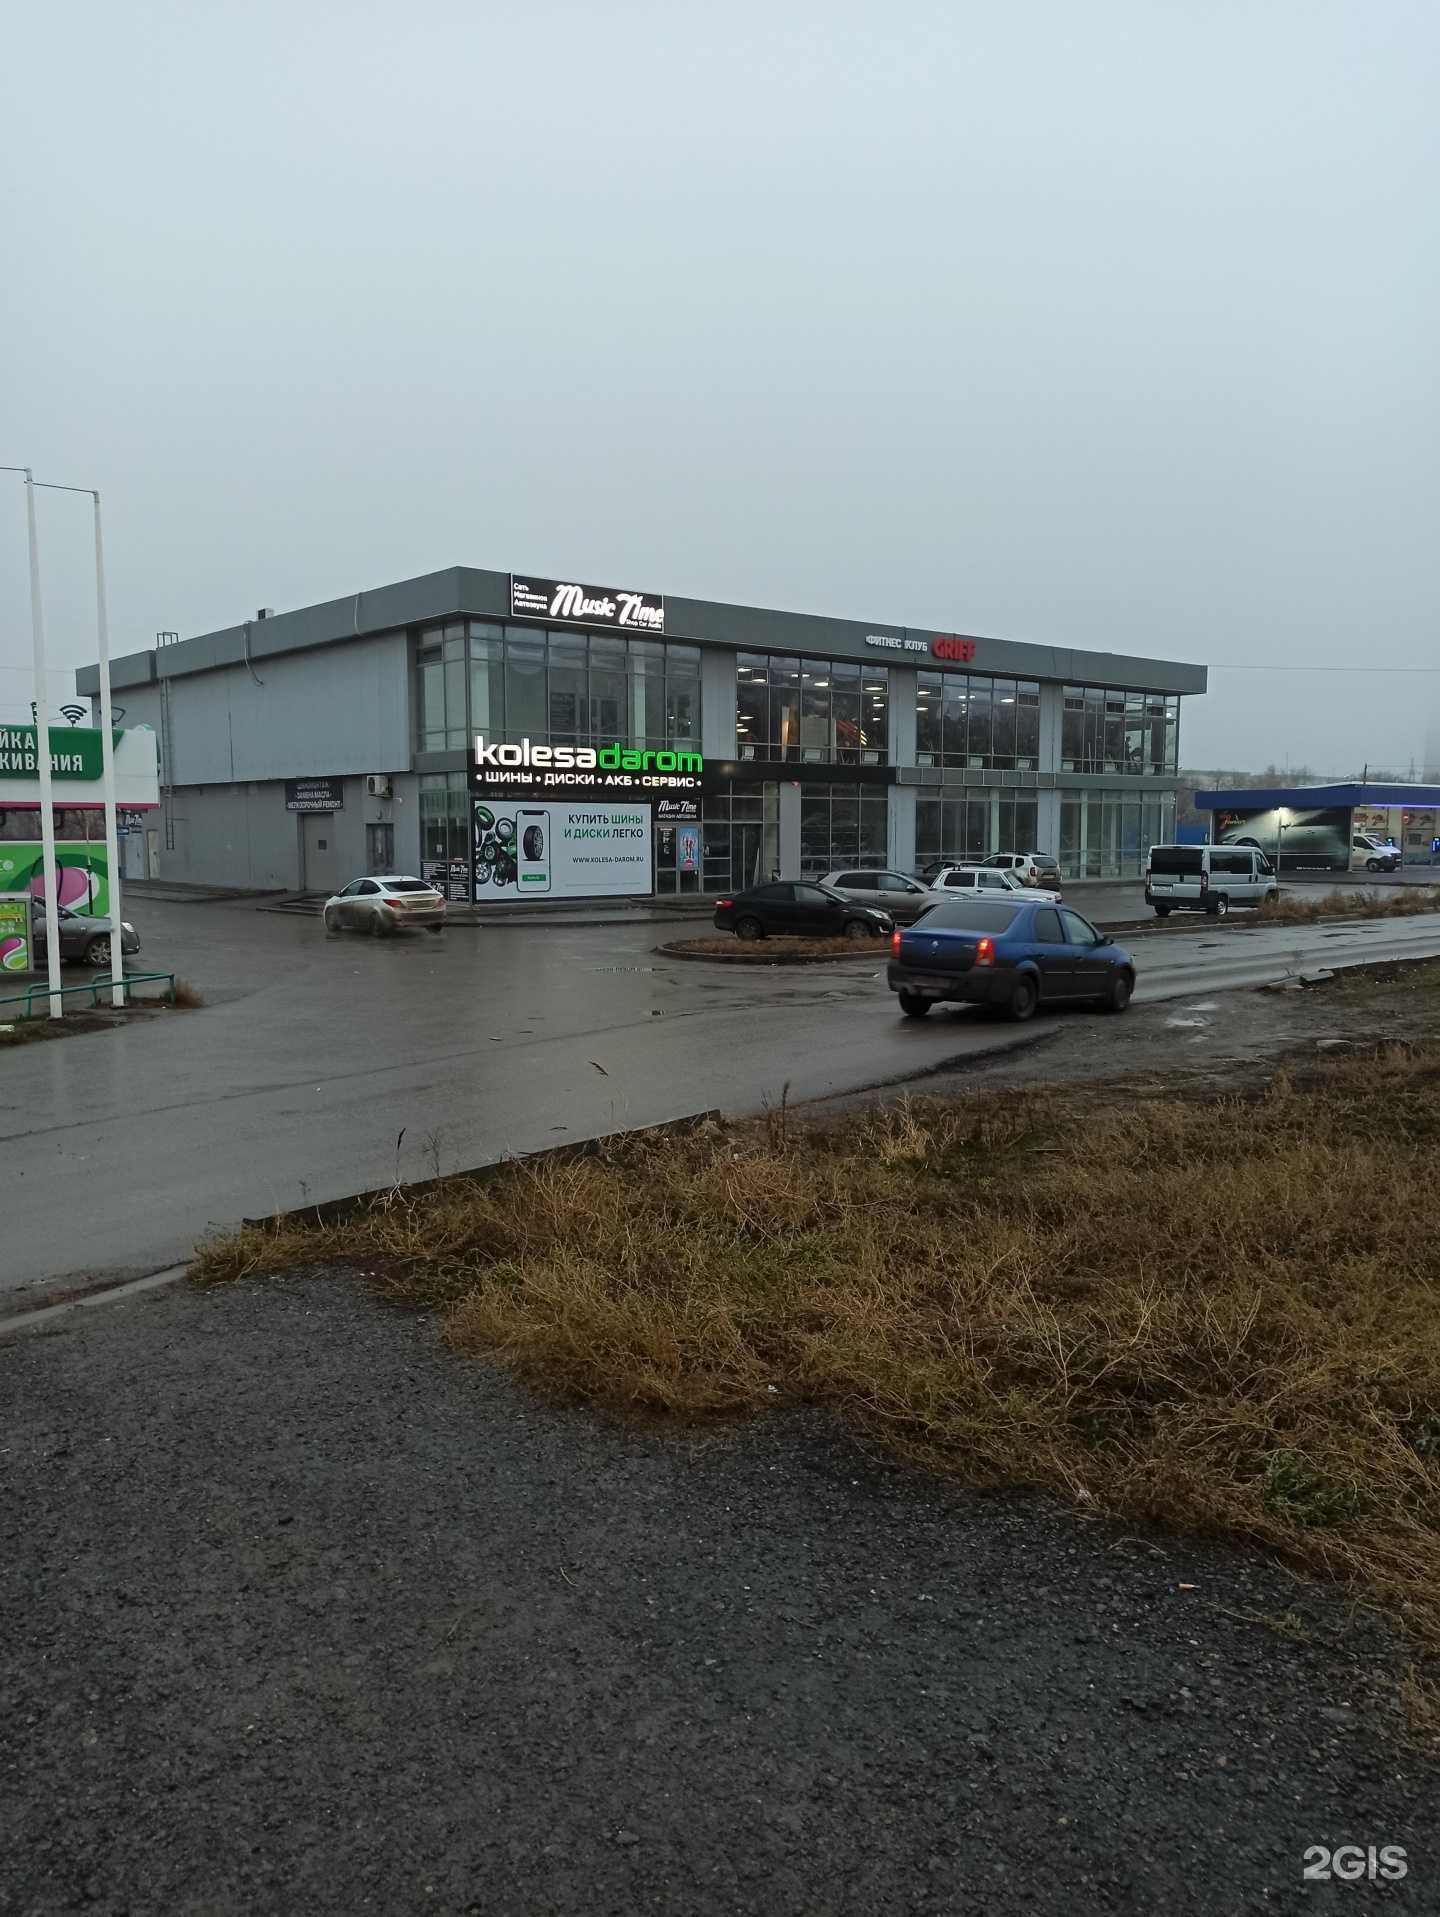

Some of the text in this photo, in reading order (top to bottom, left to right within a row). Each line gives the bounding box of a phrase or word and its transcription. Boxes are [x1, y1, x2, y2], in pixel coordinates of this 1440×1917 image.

[550, 584, 664, 625] Music Time
[865, 635, 928, 652] ФИТНЕС КЛУБ
[0, 752, 83, 771] ИВНИЯ
[486, 772, 695, 787] ШИНЫ ДИСКИ АКБ СЕРВИС
[568, 814, 643, 824] КУПИТЬ ШИНЫ
[564, 828, 644, 839] И ДИСКИ ЛЕГКО
